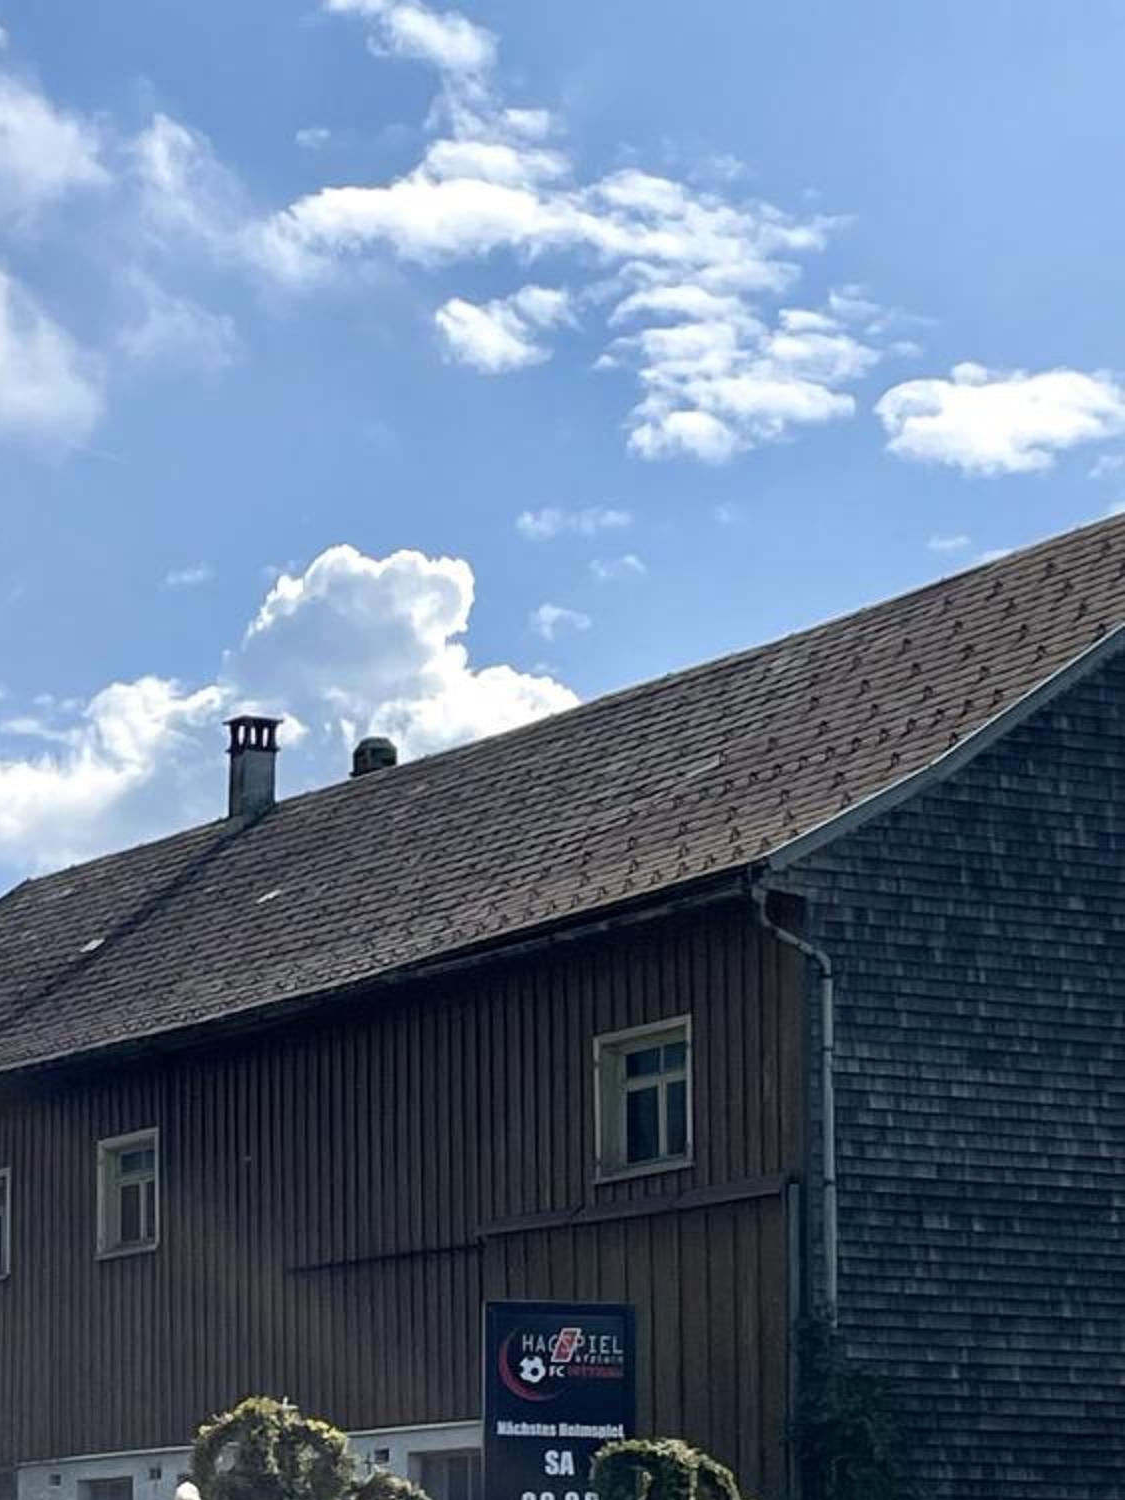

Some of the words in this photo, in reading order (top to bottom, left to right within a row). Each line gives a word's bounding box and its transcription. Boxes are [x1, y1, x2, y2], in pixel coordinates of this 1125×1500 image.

[548, 1365, 566, 1378] FC
[496, 1420, 557, 1437] Nächstes
[544, 1449, 575, 1475] SA
